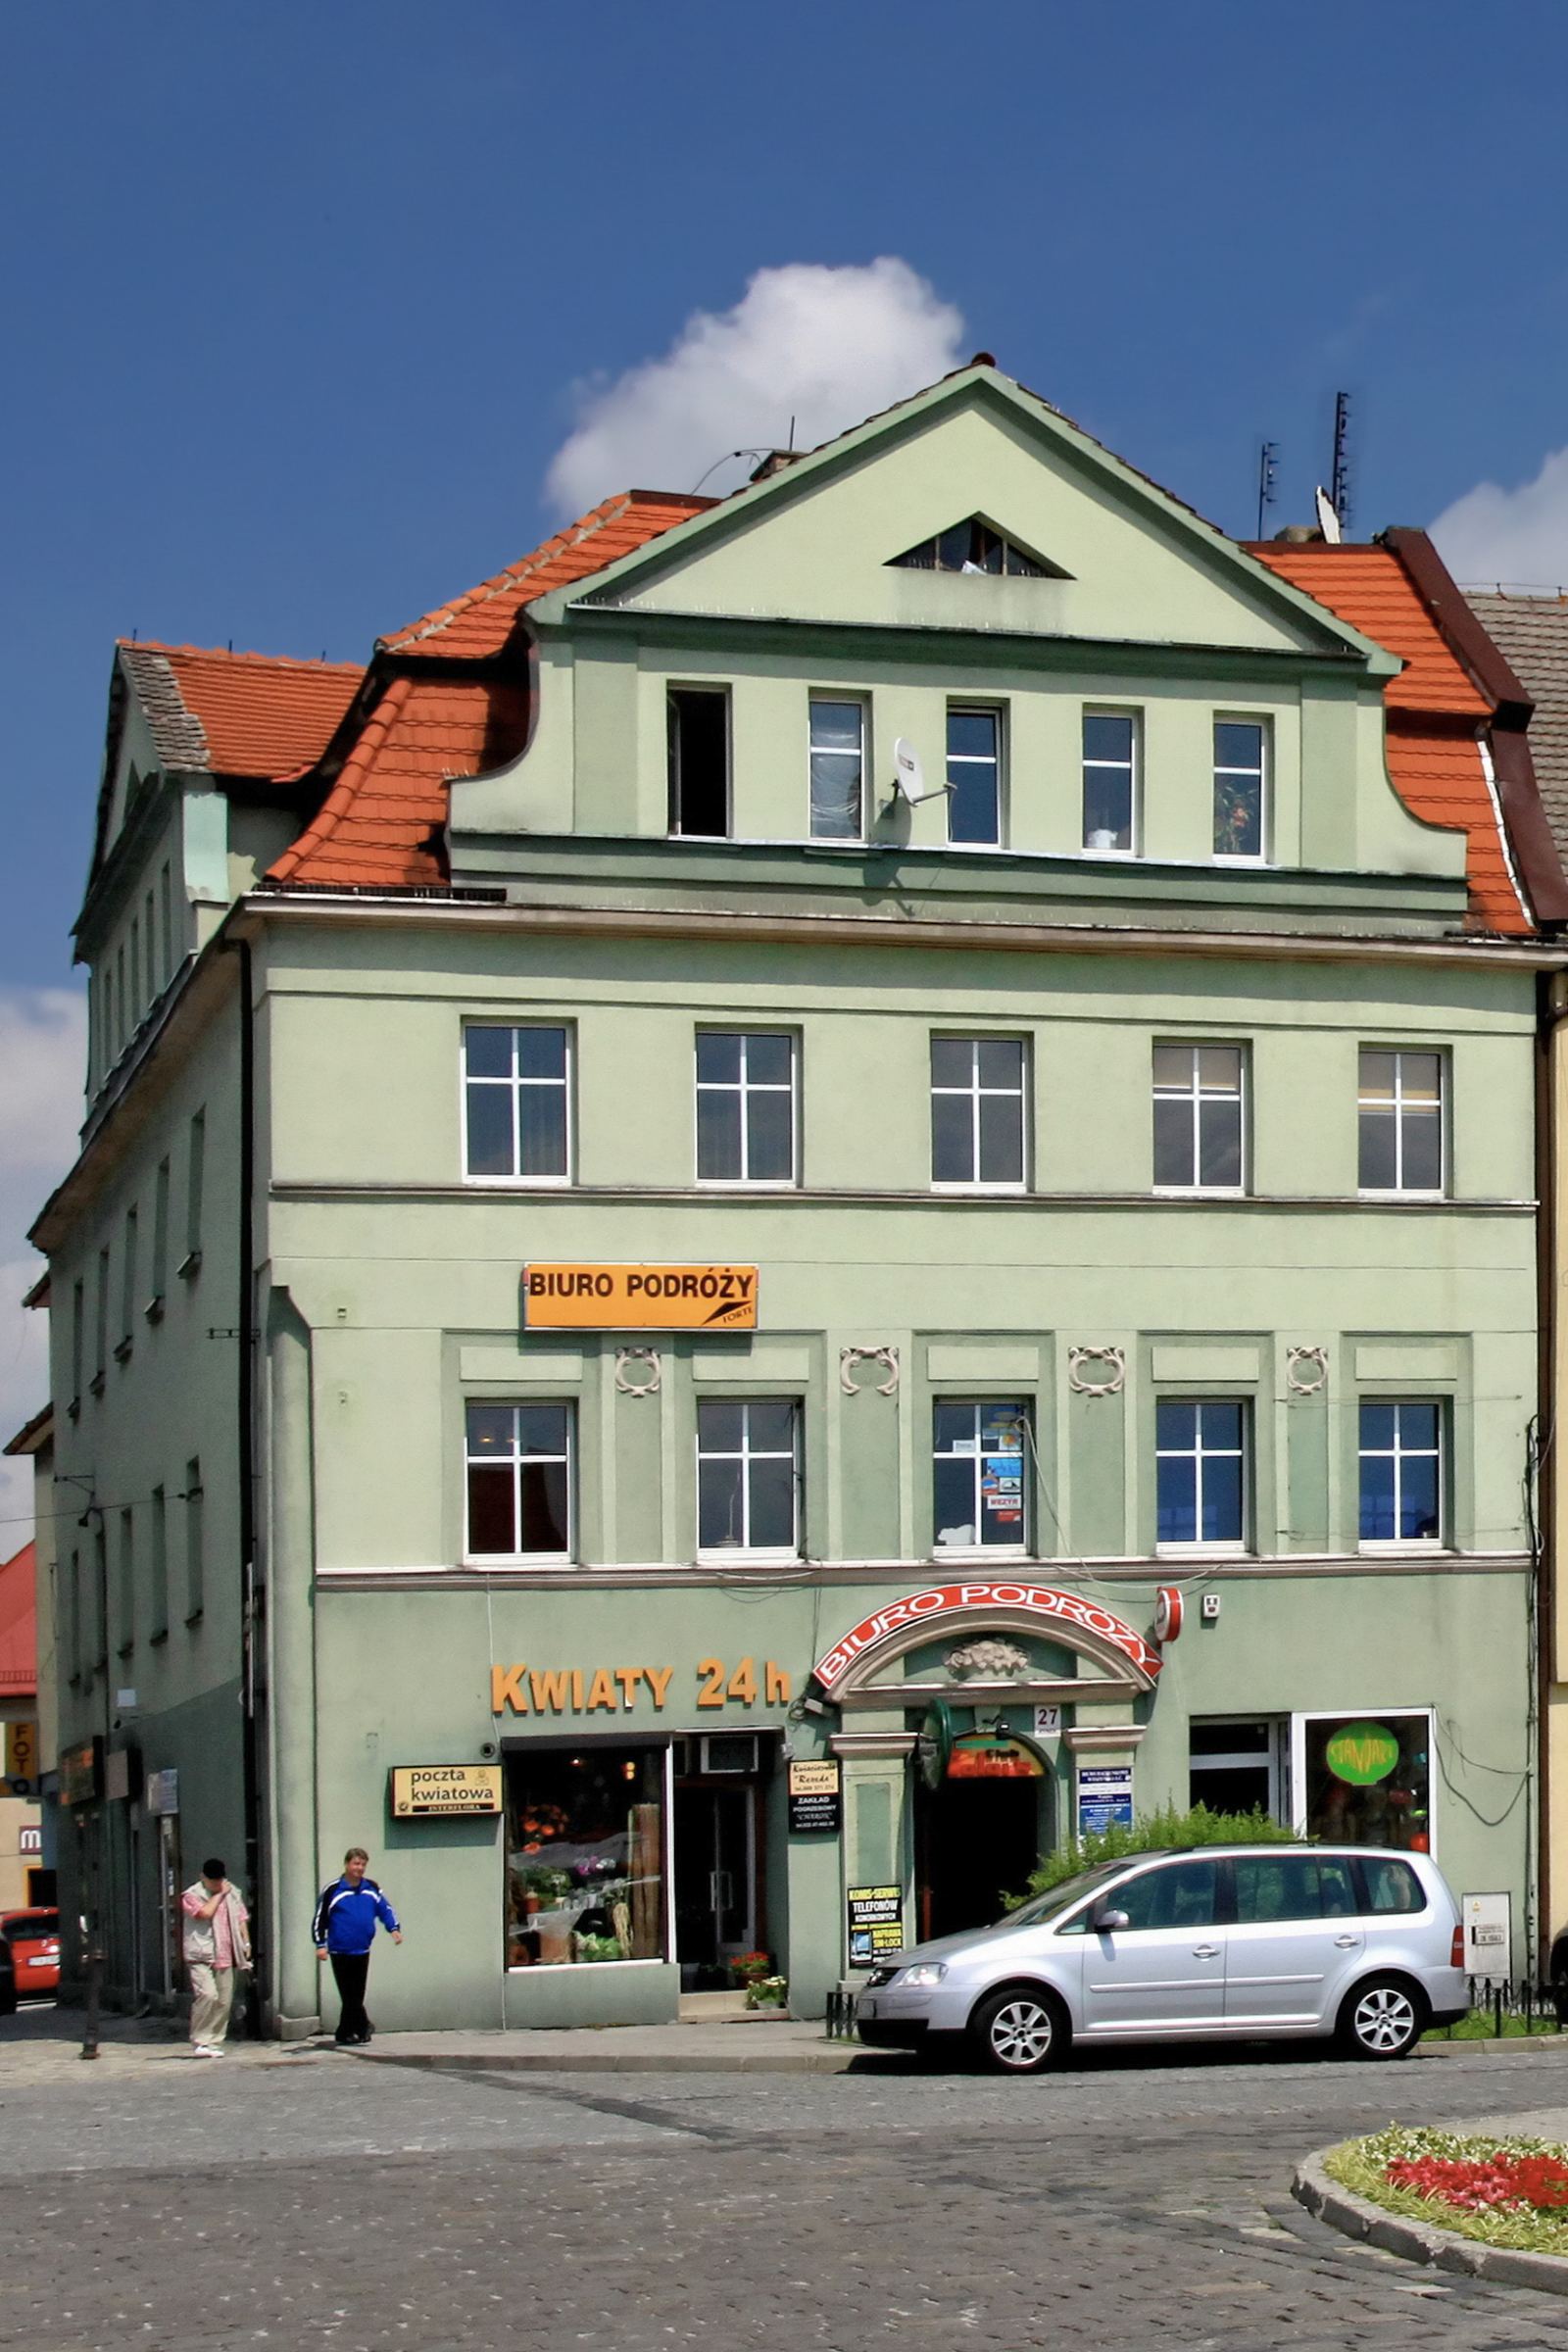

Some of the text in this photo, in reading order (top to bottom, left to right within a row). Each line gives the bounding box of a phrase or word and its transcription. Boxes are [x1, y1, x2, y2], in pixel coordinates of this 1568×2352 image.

[529, 1267, 753, 1298] BIURO PODRÓŻY
[822, 1592, 945, 1681] BIURO
[1038, 1708, 1057, 1725] 27
[411, 1768, 466, 1786] poczta
[412, 1787, 494, 1801] kwiatowa
